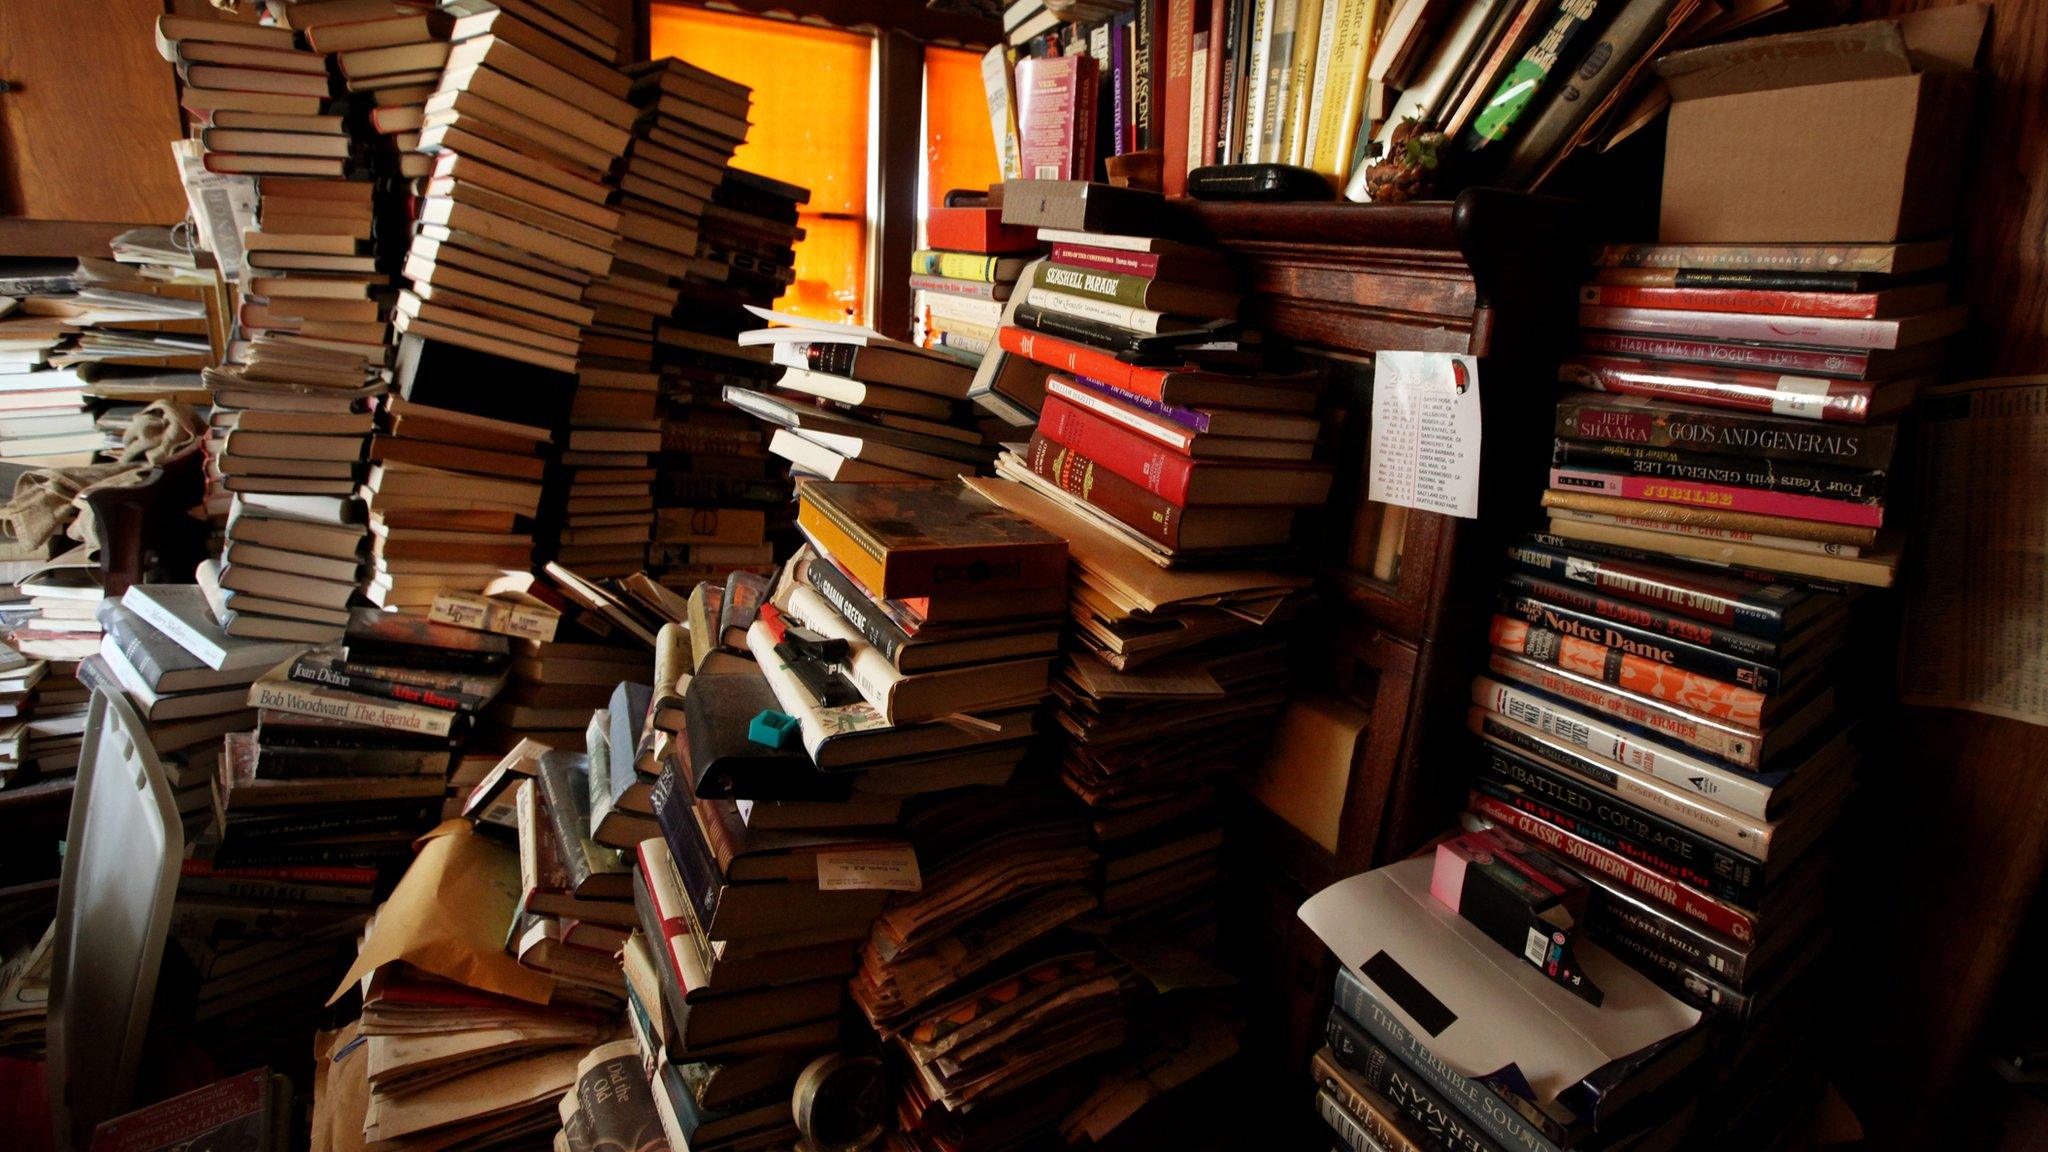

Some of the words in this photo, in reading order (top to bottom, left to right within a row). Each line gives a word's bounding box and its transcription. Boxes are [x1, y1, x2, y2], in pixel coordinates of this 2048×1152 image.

[1139, 0, 1149, 45] onowski
[1334, 0, 1352, 63] anguage
[1112, 67, 1121, 124] CORRECTIVE
[1138, 77, 1149, 130] ASCENT
[1646, 253, 1681, 263] GHOST
[1697, 255, 1750, 265] MICHAEL
[1757, 256, 1812, 266] ONDAATJE
[1045, 267, 1083, 289] SEASHELL
[1084, 274, 1119, 296] PARADE
[1619, 337, 1665, 355] HARLEM
[1690, 343, 1705, 357] IN
[1708, 345, 1754, 362] VOGUE
[1600, 411, 1632, 427] JEFF
[1580, 423, 1649, 442] SHAARA
[1668, 421, 1716, 444] GODS
[1717, 425, 1759, 448] AND
[1759, 428, 1858, 458] GENERALS
[1602, 445, 1635, 459] Taylor
[1639, 448, 1652, 459] H.
[1633, 459, 1663, 474] LEE
[1653, 449, 1679, 462] Walter
[1559, 477, 1604, 489] GRANTA
[1665, 460, 1742, 483] GENERAL
[1745, 469, 1776, 486] with
[1780, 474, 1822, 493] Years
[1643, 484, 1734, 505] JUBILEE
[1826, 480, 1863, 497] Four
[1614, 514, 1630, 525] THE
[1630, 516, 1662, 529] CAUSES
[1674, 523, 1694, 535] THE
[1699, 525, 1724, 538] CIVIL
[1729, 528, 1754, 541] WAR
[823, 579, 845, 611] GRAHAM
[843, 599, 868, 633] GREENE
[1602, 572, 1637, 595] DRAWN
[1638, 578, 1662, 600] WITH
[1663, 583, 1686, 605] THE
[1687, 592, 1727, 616] SWORD
[1532, 583, 1593, 609] THROUGH
[1595, 599, 1651, 628] BLOOD
[1666, 620, 1713, 645] FIRE
[1734, 606, 1768, 622] OXFORD
[1543, 610, 1601, 642] Notre
[1604, 629, 1675, 665] Dame
[293, 663, 317, 682] Joan
[316, 667, 351, 688] Didion
[391, 683, 421, 702] After
[421, 689, 458, 709] Henry
[259, 689, 284, 708] Bob
[286, 693, 350, 718] Woodward
[353, 705, 377, 722] The
[377, 711, 422, 730] Agenda
[1509, 697, 1525, 718] THE
[1524, 702, 1541, 730] WAR
[1541, 671, 1560, 689] THE
[1561, 676, 1606, 706] PASSING
[1607, 694, 1623, 709] OF
[1623, 699, 1649, 720] THE
[1649, 710, 1697, 739] ARMIES
[1555, 713, 1573, 745] THE
[1491, 756, 1593, 810] EMBATTLED
[1597, 803, 1694, 860] COURAGE
[1625, 781, 1658, 802] JOSEPH
[1673, 800, 1721, 829] STEVENS
[1517, 813, 1563, 849] CLASSIC
[1566, 838, 1629, 885] SOUTHERN
[1631, 872, 1679, 907] HUMOR
[1684, 900, 1709, 923] Koon
[1616, 832, 1679, 877] Melting
[229, 883, 308, 899] DEFIANCE
[1637, 917, 1669, 947] STEEL
[1668, 931, 1701, 958] WILLS
[608, 1062, 628, 1084] Did
[1369, 1003, 1405, 1042] THIS
[1406, 1031, 1480, 1103] TERRIBLE
[1481, 1096, 1550, 1152] SOUND
[594, 1078, 614, 1104] Old
[615, 1085, 632, 1103] the
[1347, 1094, 1374, 1129] LEE
